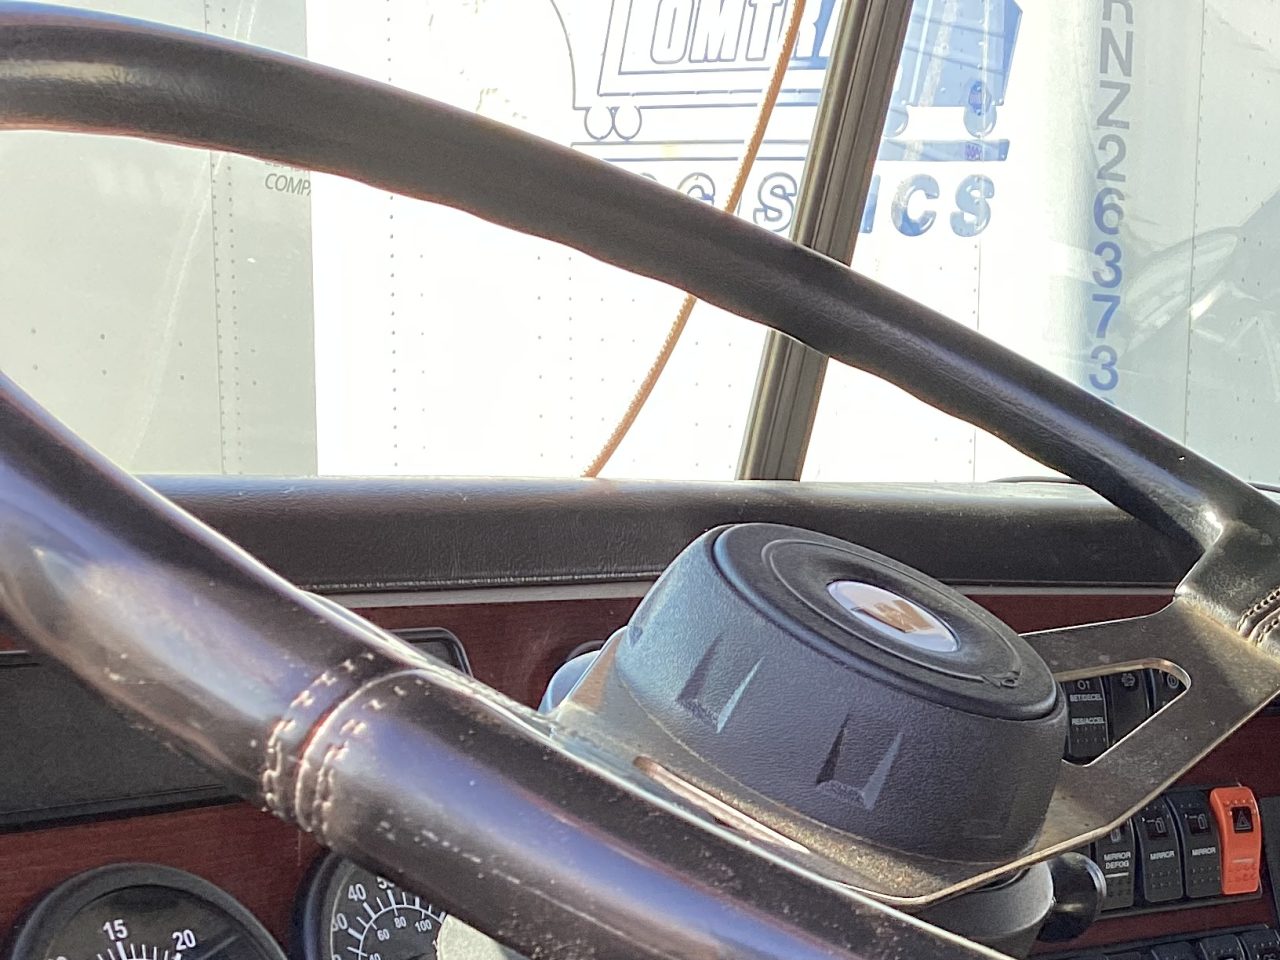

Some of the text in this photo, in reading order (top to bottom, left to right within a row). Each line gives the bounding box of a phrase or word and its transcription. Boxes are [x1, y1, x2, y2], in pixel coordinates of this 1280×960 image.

[264, 172, 312, 197] COMP
[1088, 0, 1135, 404] NZ26373
[1103, 851, 1132, 861] MIRROR
[1105, 860, 1130, 870] DEFOG
[347, 883, 367, 901] 40
[102, 919, 128, 941] 15
[394, 916, 407, 929] 80
[414, 918, 432, 932] 100
[172, 929, 197, 951] 20
[376, 927, 390, 942] 60
